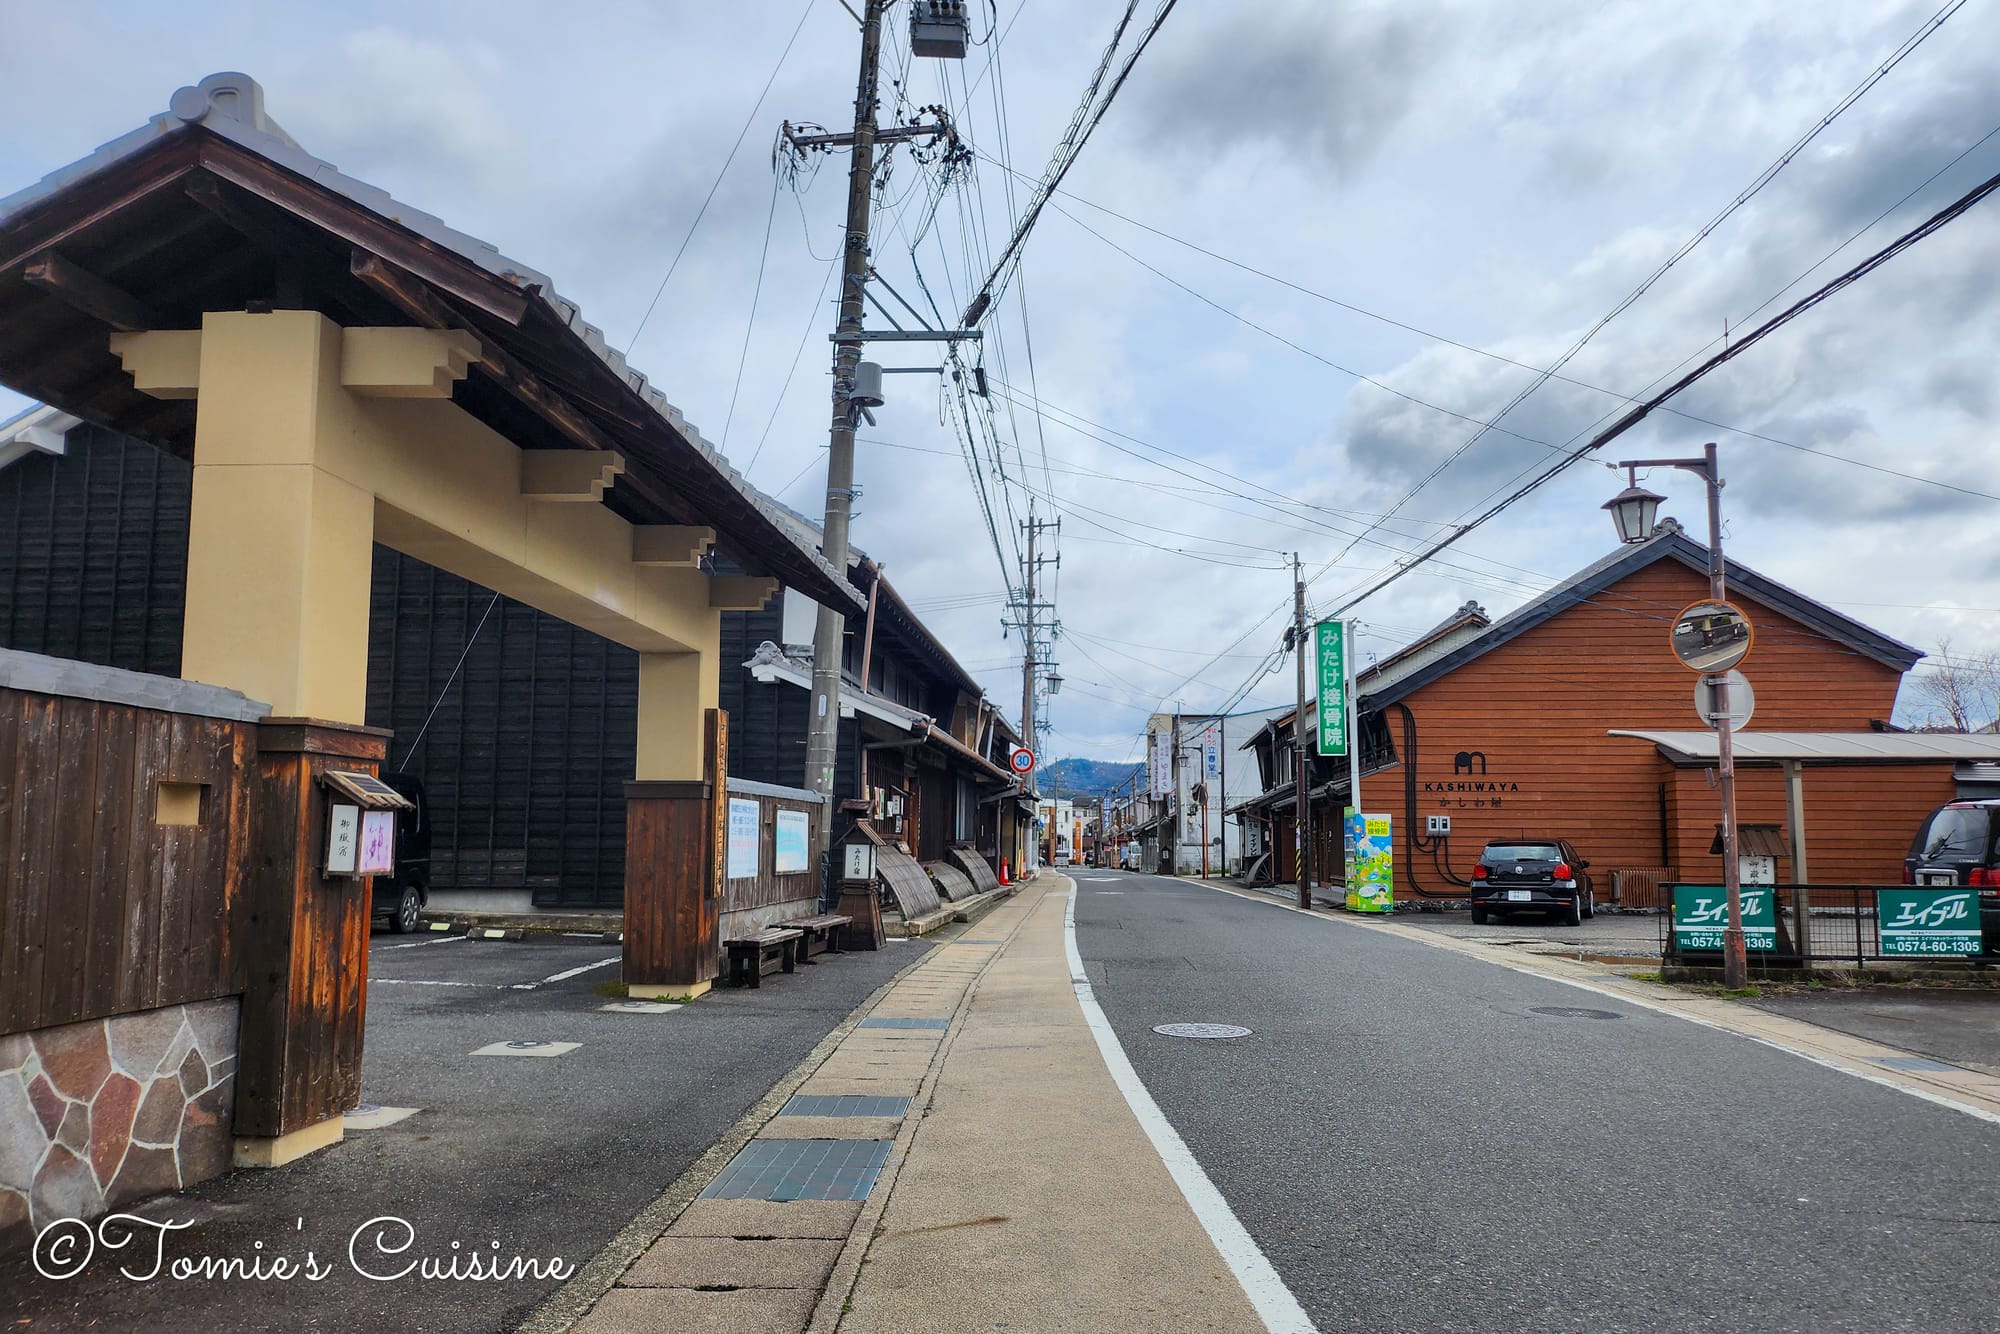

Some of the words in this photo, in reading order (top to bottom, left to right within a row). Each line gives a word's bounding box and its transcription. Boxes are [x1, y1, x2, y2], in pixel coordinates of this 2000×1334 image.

[1322, 629, 1343, 746] みたけ接骨院
[1015, 754, 1030, 769] 30
[1425, 783, 1519, 792] KASHIWAYA
[1682, 890, 1765, 923] エイル
[1886, 894, 1971, 927] エイブル
[1897, 941, 1980, 952] 0574-60-1305
